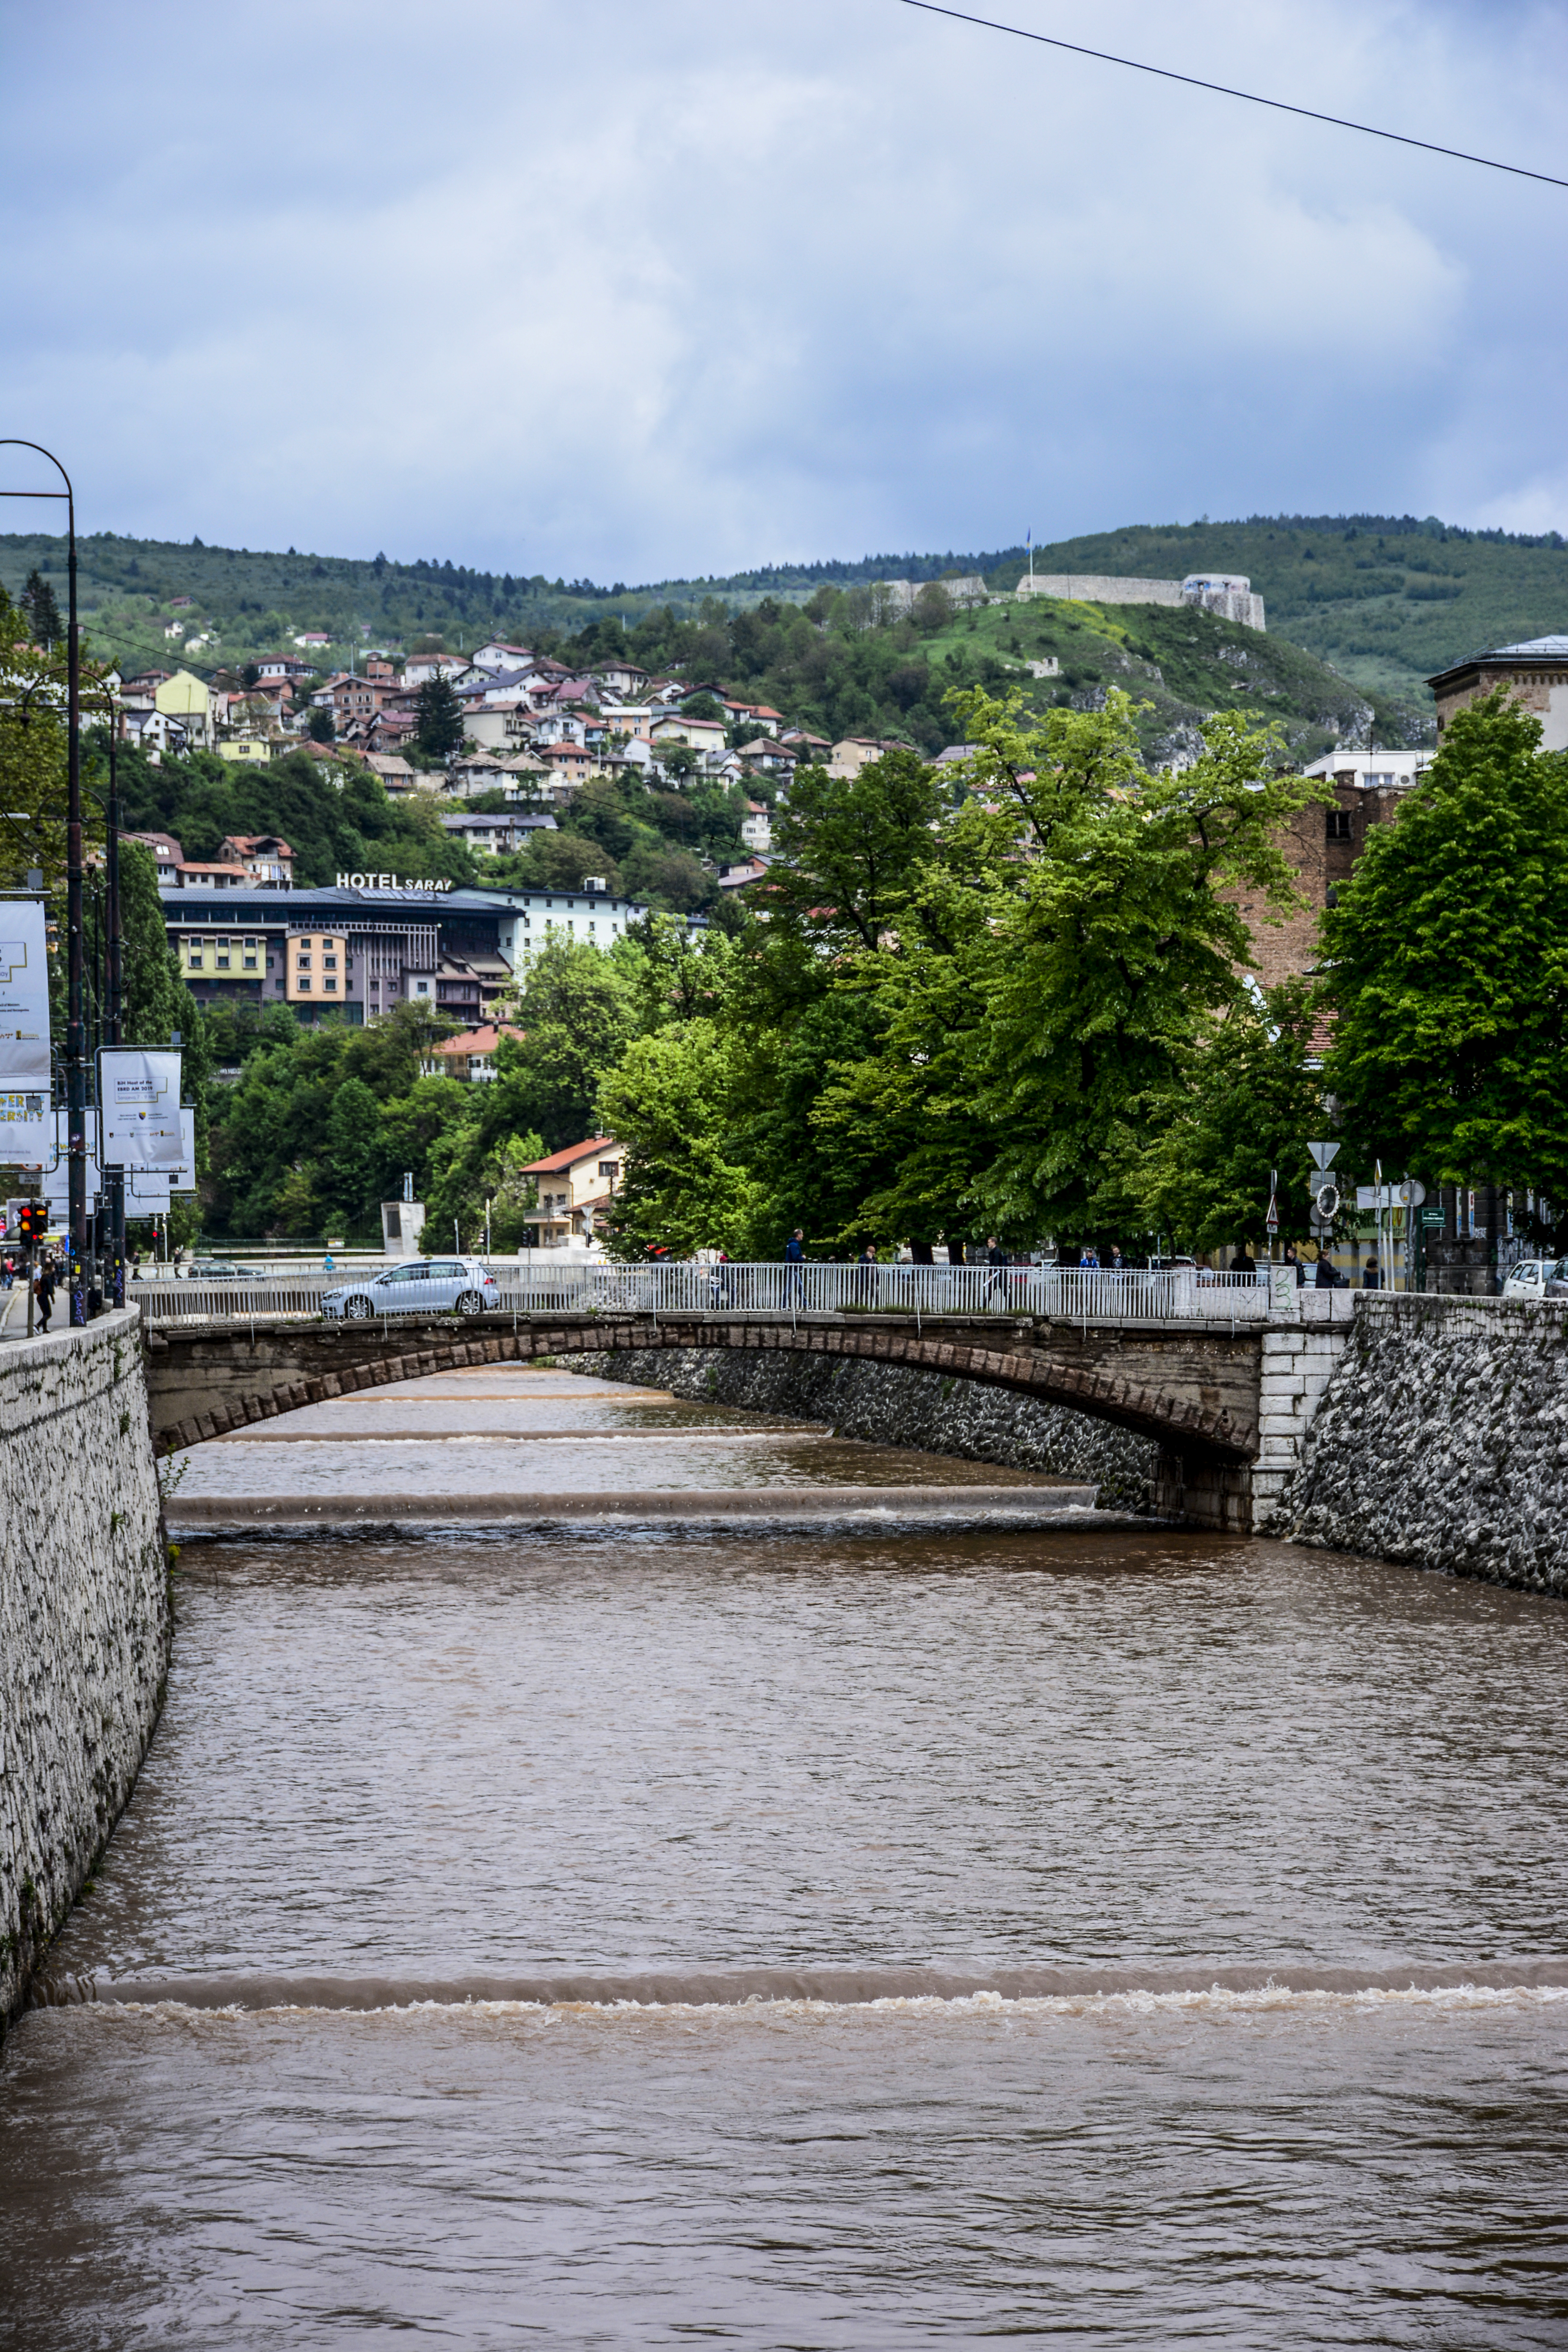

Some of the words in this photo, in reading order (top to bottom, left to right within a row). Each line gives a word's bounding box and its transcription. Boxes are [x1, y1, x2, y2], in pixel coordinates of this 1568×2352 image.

[336, 873, 403, 890] HOTEL
[405, 878, 452, 891] SARAY
[0, 1095, 24, 1107] WER
[0, 1109, 44, 1122] ERSITY
